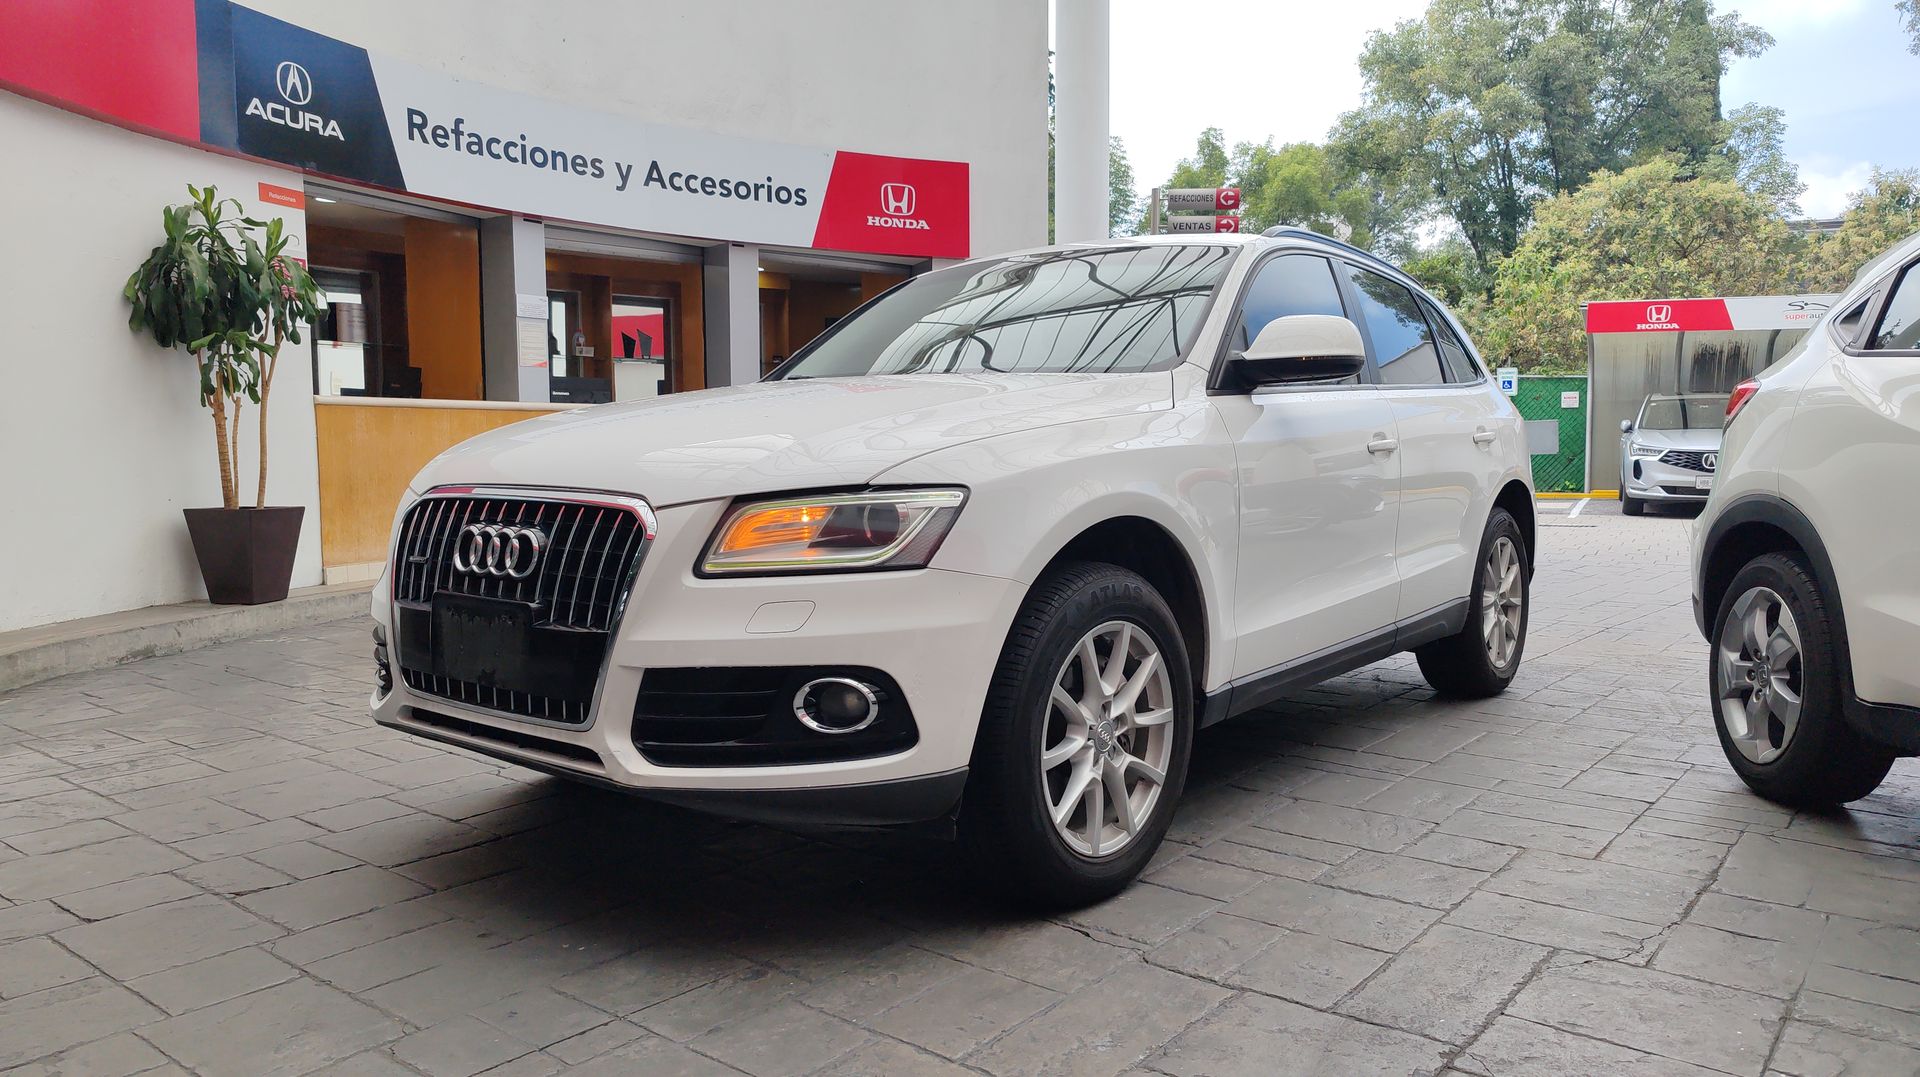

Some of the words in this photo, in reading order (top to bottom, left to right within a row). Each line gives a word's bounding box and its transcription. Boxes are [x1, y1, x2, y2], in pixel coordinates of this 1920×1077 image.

[245, 97, 345, 141] ACURA
[406, 107, 605, 179] Refacciones
[614, 161, 633, 192] y
[643, 160, 808, 207] Accesorios
[1169, 194, 1214, 203] REFACCIONES
[866, 215, 930, 230] HONDA
[1172, 222, 1212, 231] VENTAS
